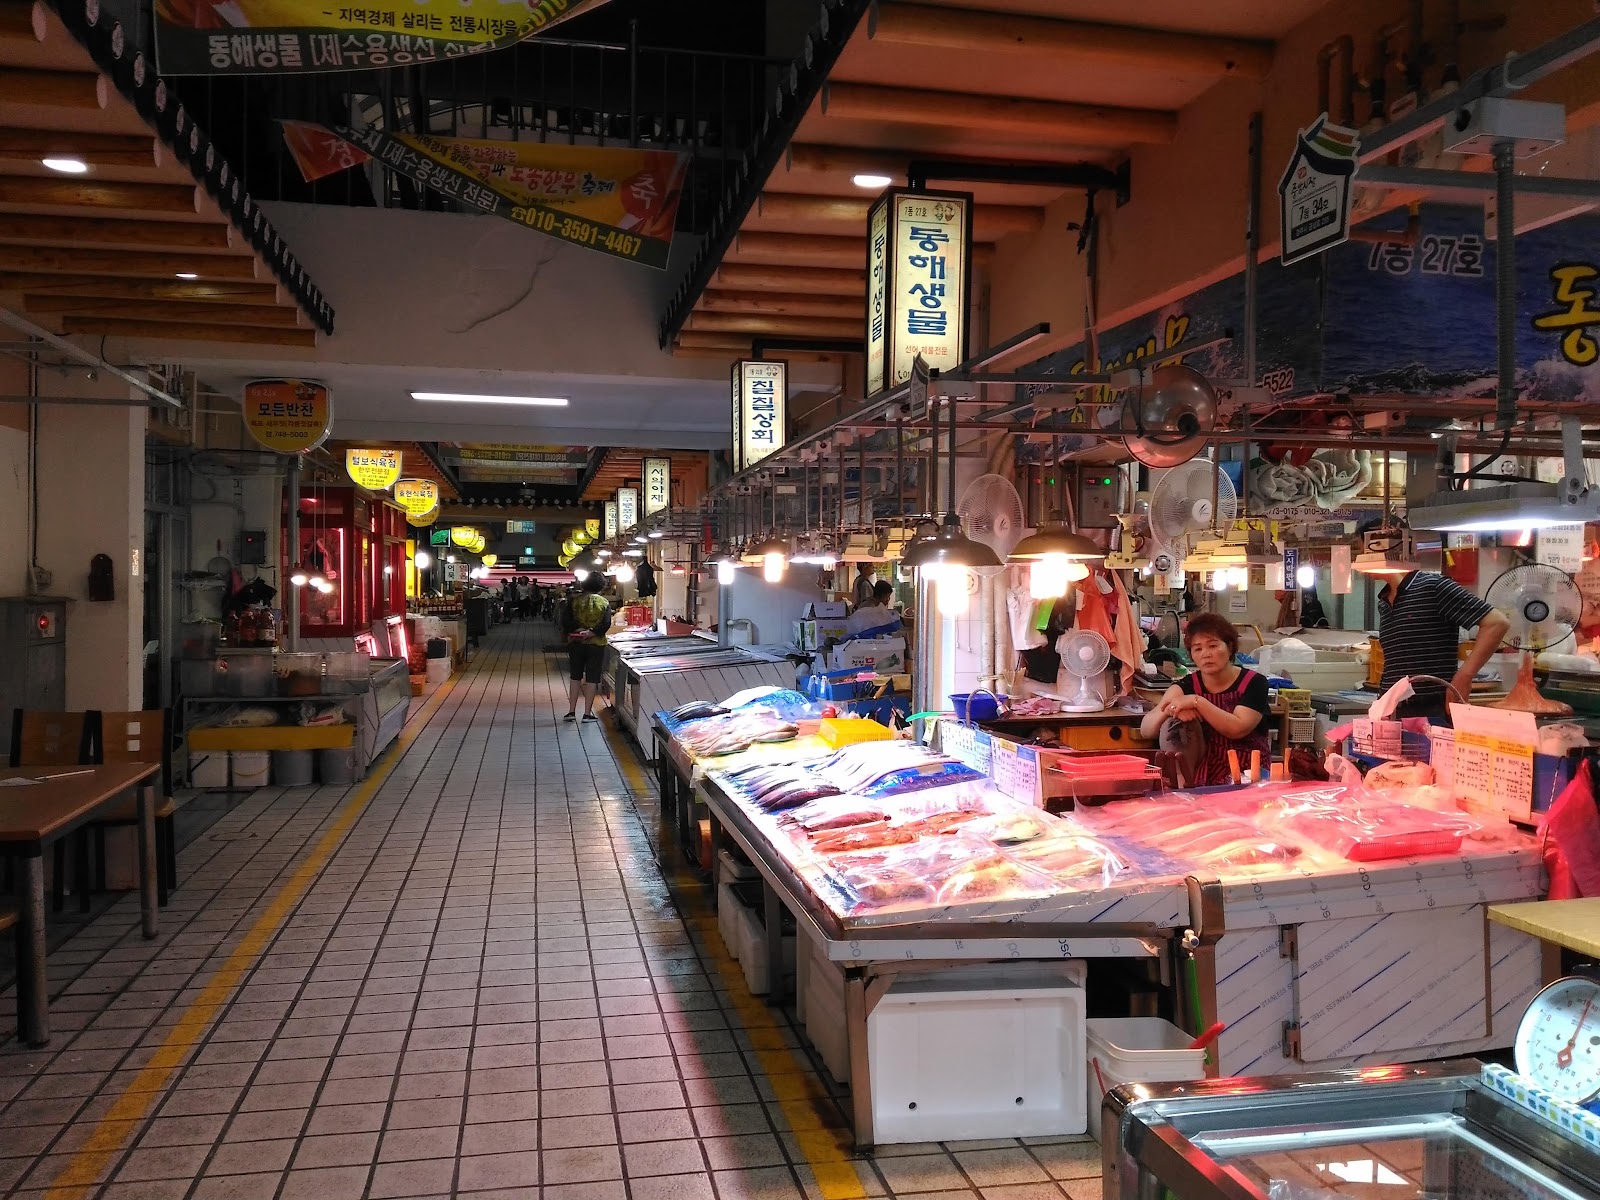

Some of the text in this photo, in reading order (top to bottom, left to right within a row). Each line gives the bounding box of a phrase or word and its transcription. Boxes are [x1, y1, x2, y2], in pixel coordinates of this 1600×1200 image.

[339, 8, 517, 36] 지역경제 살리는 전통시장을
[208, 34, 302, 68] 동해생물
[309, 33, 436, 66] [제수용생선
[382, 140, 500, 212] [제수용생선 전문]
[581, 171, 615, 196] 축제
[525, 206, 642, 257] 010-3591-4467
[1421, 233, 1485, 277] 27호
[907, 225, 950, 337] 동해생물
[258, 402, 314, 417] 모든반찬
[352, 456, 396, 469] 털보식육점
